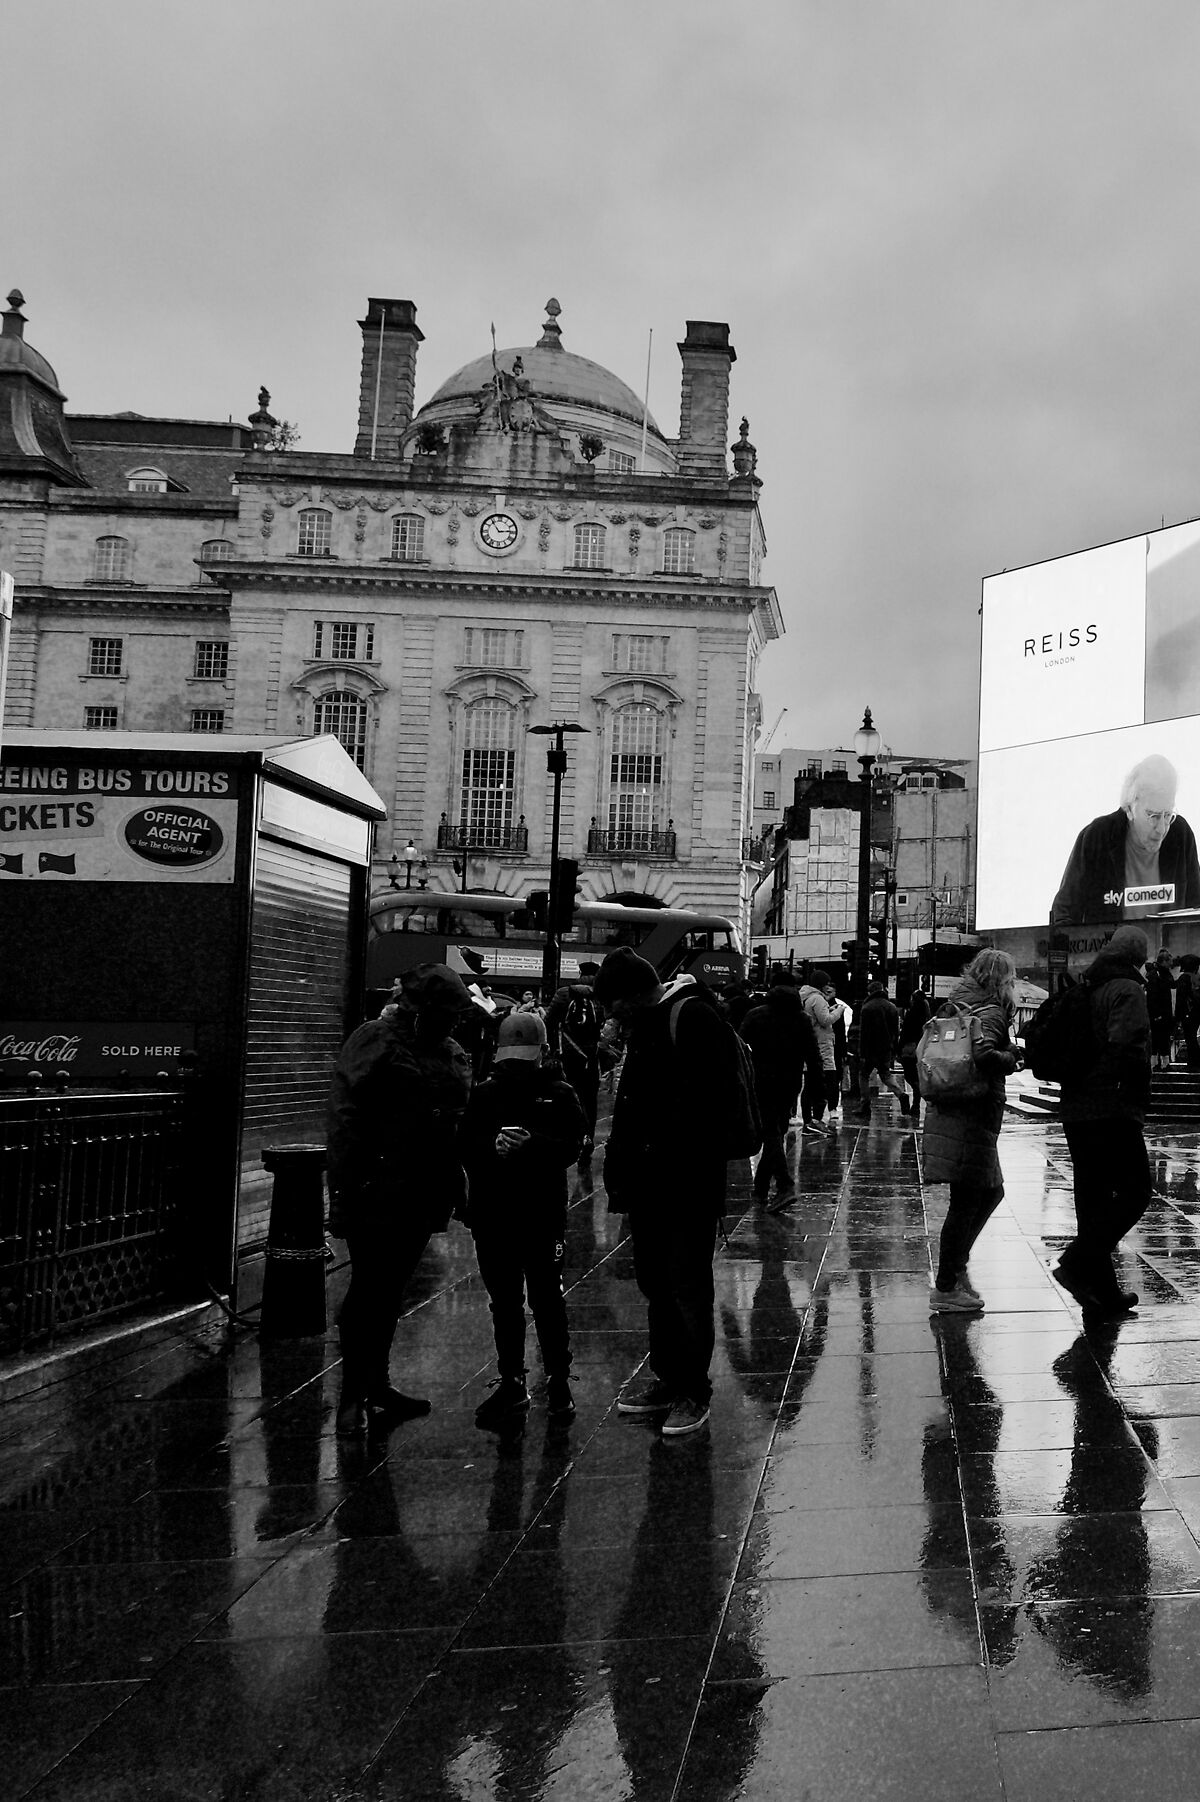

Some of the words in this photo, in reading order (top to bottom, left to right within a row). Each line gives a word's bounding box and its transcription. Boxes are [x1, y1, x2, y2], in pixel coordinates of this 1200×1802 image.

[1024, 624, 1098, 657] REISS
[1045, 656, 1076, 668] LONDON
[78, 769, 132, 791] BUS
[141, 770, 229, 793] TOURS
[143, 810, 211, 831] OFFICIAL
[146, 826, 202, 844] AGENT
[138, 839, 148, 847] for
[150, 841, 161, 849] The
[162, 843, 188, 853] Original
[190, 847, 204, 855] Tour
[1103, 889, 1124, 907] sky
[1127, 887, 1173, 902] comedy
[101, 1045, 140, 1056] SOLD
[144, 1045, 182, 1056] HERE
